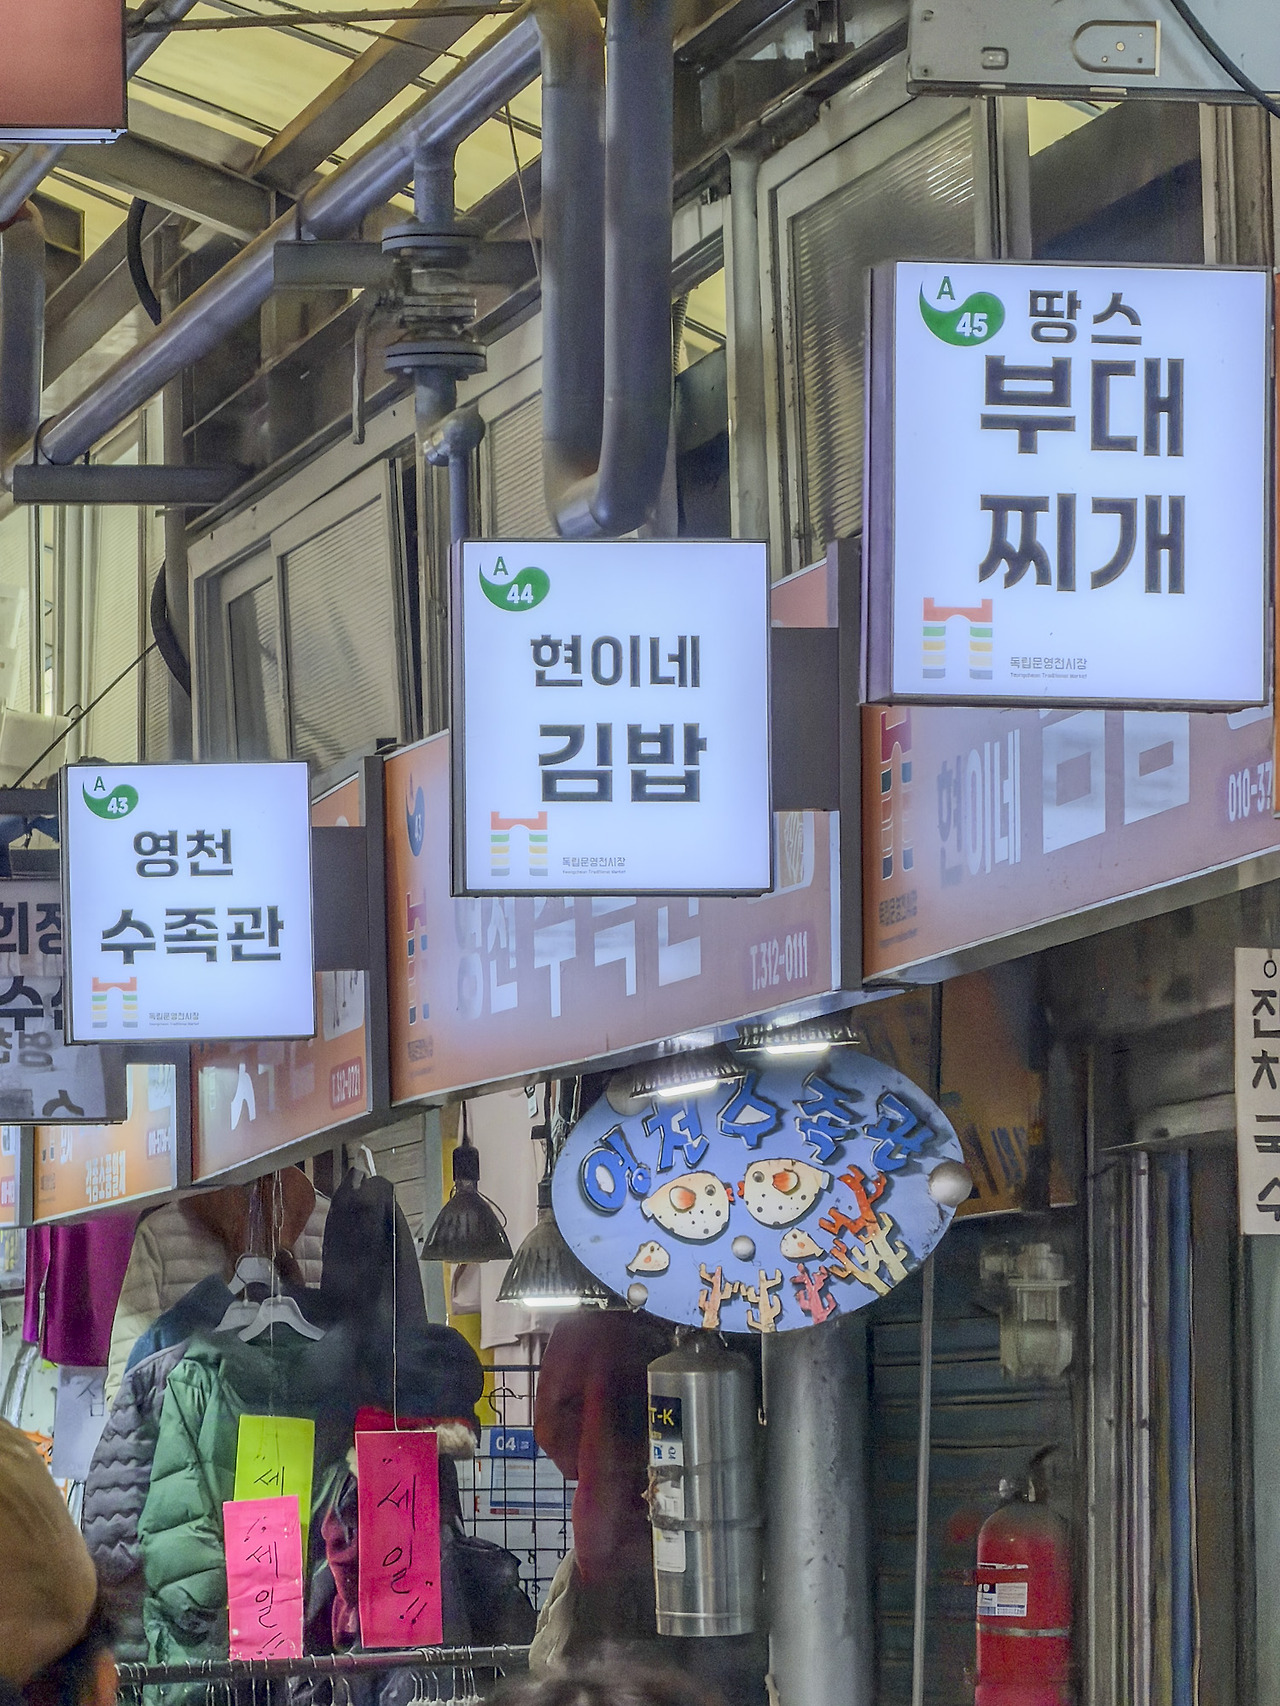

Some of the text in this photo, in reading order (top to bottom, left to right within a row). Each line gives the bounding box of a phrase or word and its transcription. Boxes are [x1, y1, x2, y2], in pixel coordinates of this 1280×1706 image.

[936, 276, 956, 301] A
[955, 312, 989, 338] 45
[1029, 289, 1142, 346] 땅스
[980, 354, 1185, 457] 부대
[978, 493, 1186, 594] 찌개
[493, 556, 509, 576] A
[506, 583, 534, 604] 44
[530, 634, 701, 688] 현이네
[1010, 656, 1088, 670] 독립문영천시장
[538, 722, 708, 803] 김밥
[93, 776, 106, 792] A
[106, 796, 129, 814] 43
[133, 828, 234, 878] 영천
[562, 857, 626, 867] 독립문영천시장
[100, 905, 285, 965] 수족관
[750, 931, 809, 991] T.312-0111
